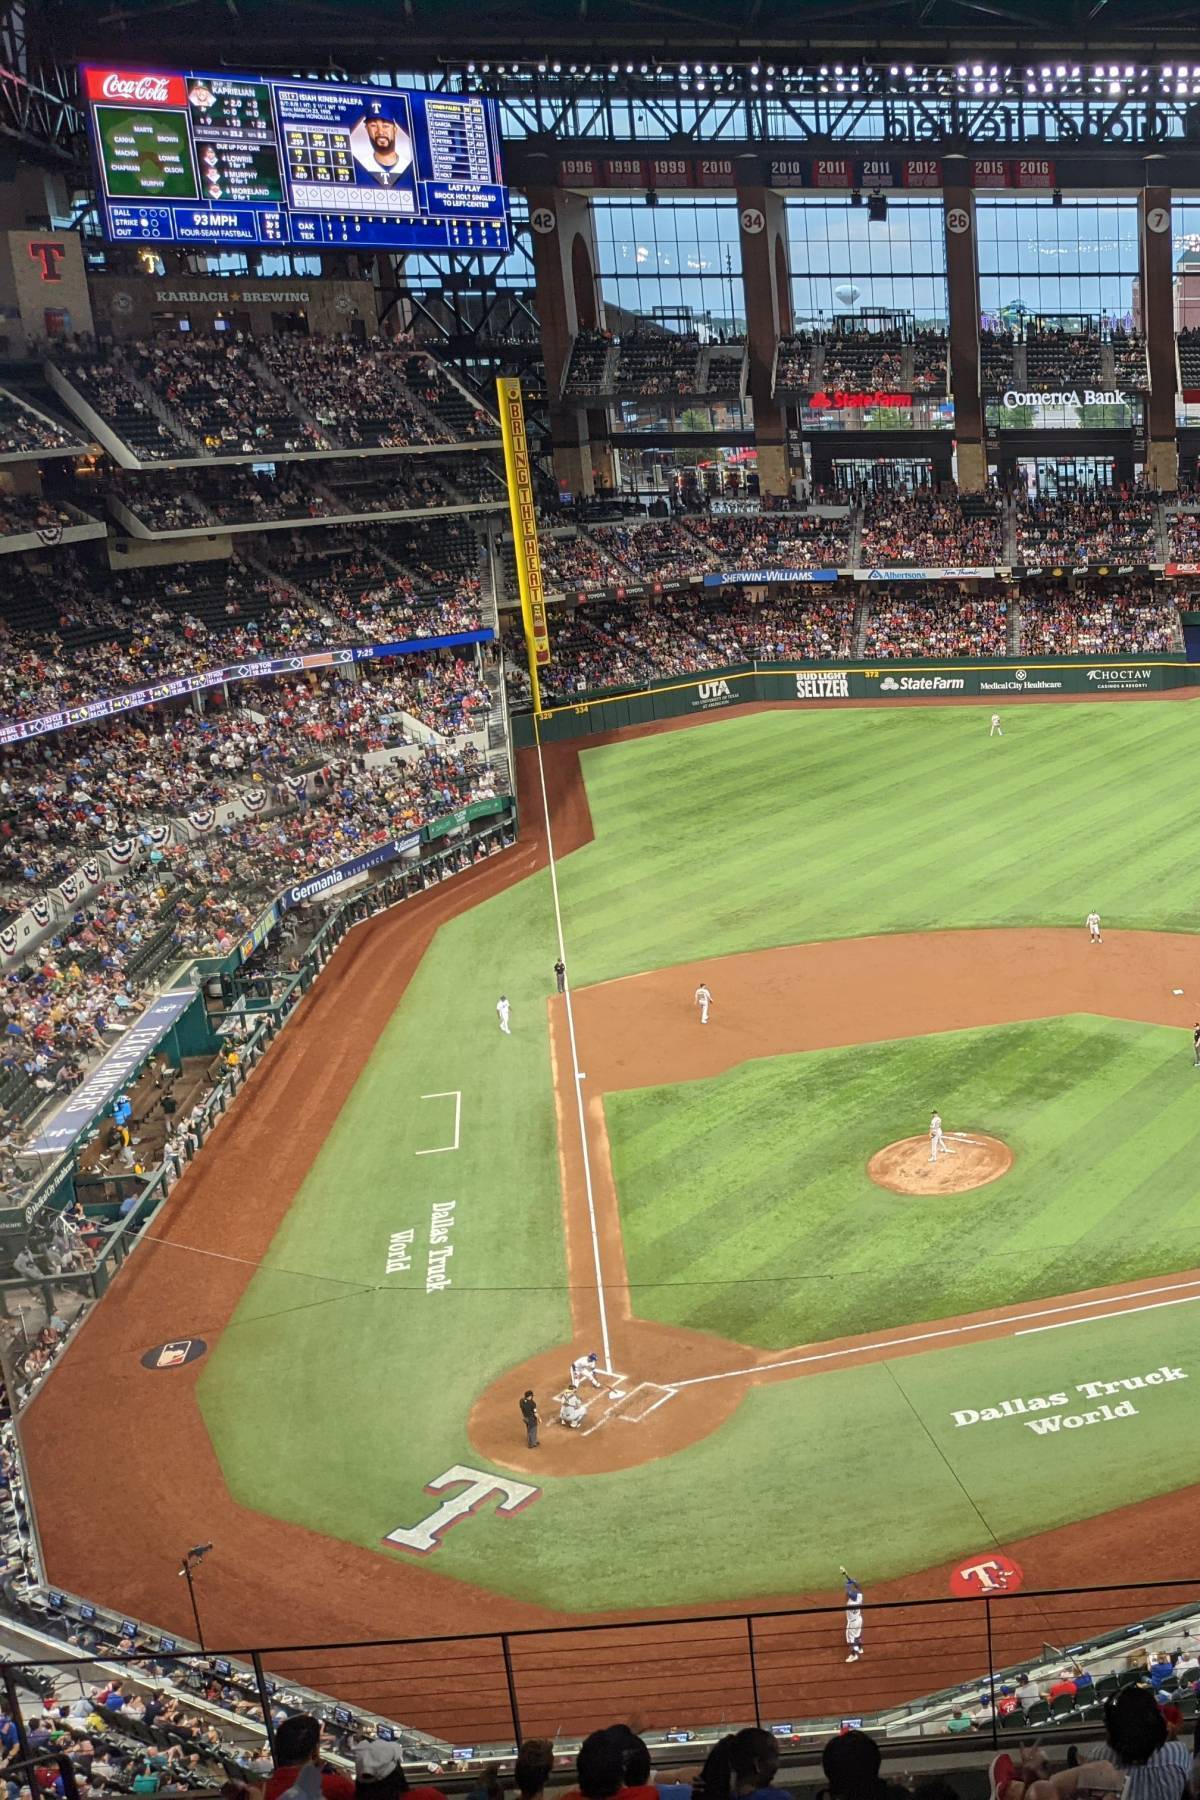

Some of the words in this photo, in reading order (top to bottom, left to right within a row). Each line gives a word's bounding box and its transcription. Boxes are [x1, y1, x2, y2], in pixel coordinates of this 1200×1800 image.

[102, 74, 169, 101] Coca-Cola
[561, 160, 592, 173] 1996
[609, 160, 640, 173] 1998
[654, 160, 686, 174] 1999
[702, 161, 732, 174] 2010
[771, 161, 800, 174] 2010
[818, 161, 846, 174] 2011
[863, 162, 890, 175] 2011
[908, 161, 937, 174] 2012
[975, 161, 1003, 174] 2015
[1020, 161, 1049, 174] 2016
[231, 187, 269, 195] MORELAND
[193, 214, 210, 226] 93
[210, 215, 238, 227] MPH
[298, 222, 314, 231] OAK
[534, 214, 552, 227] 42
[743, 214, 762, 228] 34
[949, 213, 966, 228] 26
[1154, 213, 1163, 228] 7
[180, 229, 220, 238] FOUR-SEAM
[221, 230, 252, 238] FASTBALL
[301, 232, 315, 240] TEX
[156, 292, 229, 303] KARBACH
[242, 292, 310, 303] BREWING
[1084, 389, 1127, 405] Bank
[510, 404, 527, 484] BRING
[520, 489, 534, 535] THE
[526, 541, 540, 602] HEAT
[943, 569, 958, 577] Tom
[959, 568, 979, 577] Thumb
[1177, 563, 1199, 571] DEX
[721, 569, 815, 584] SHERWIN-WILLIAMS
[883, 569, 927, 580] Albertsons
[356, 649, 374, 658] 7:25
[796, 673, 817, 681] BUD
[818, 672, 847, 680] LIGHT
[1093, 669, 1152, 680] CHOCTAW
[698, 680, 731, 700] UTA
[796, 679, 849, 698] SELTZER
[980, 681, 1008, 690] Medical
[1008, 681, 1023, 692] City
[1024, 680, 1062, 689] Healthcare
[291, 869, 343, 902] Germania
[344, 855, 385, 878] INSURANCE
[112, 1025, 163, 1060] TEXAS
[65, 1061, 133, 1114] RANGERS
[429, 1200, 456, 1245] Dallas
[385, 1228, 415, 1274] World
[426, 1245, 454, 1294] Truck
[950, 1392, 1069, 1428] Dallas
[1076, 1366, 1188, 1399] Truck
[1024, 1400, 1139, 1435] World
